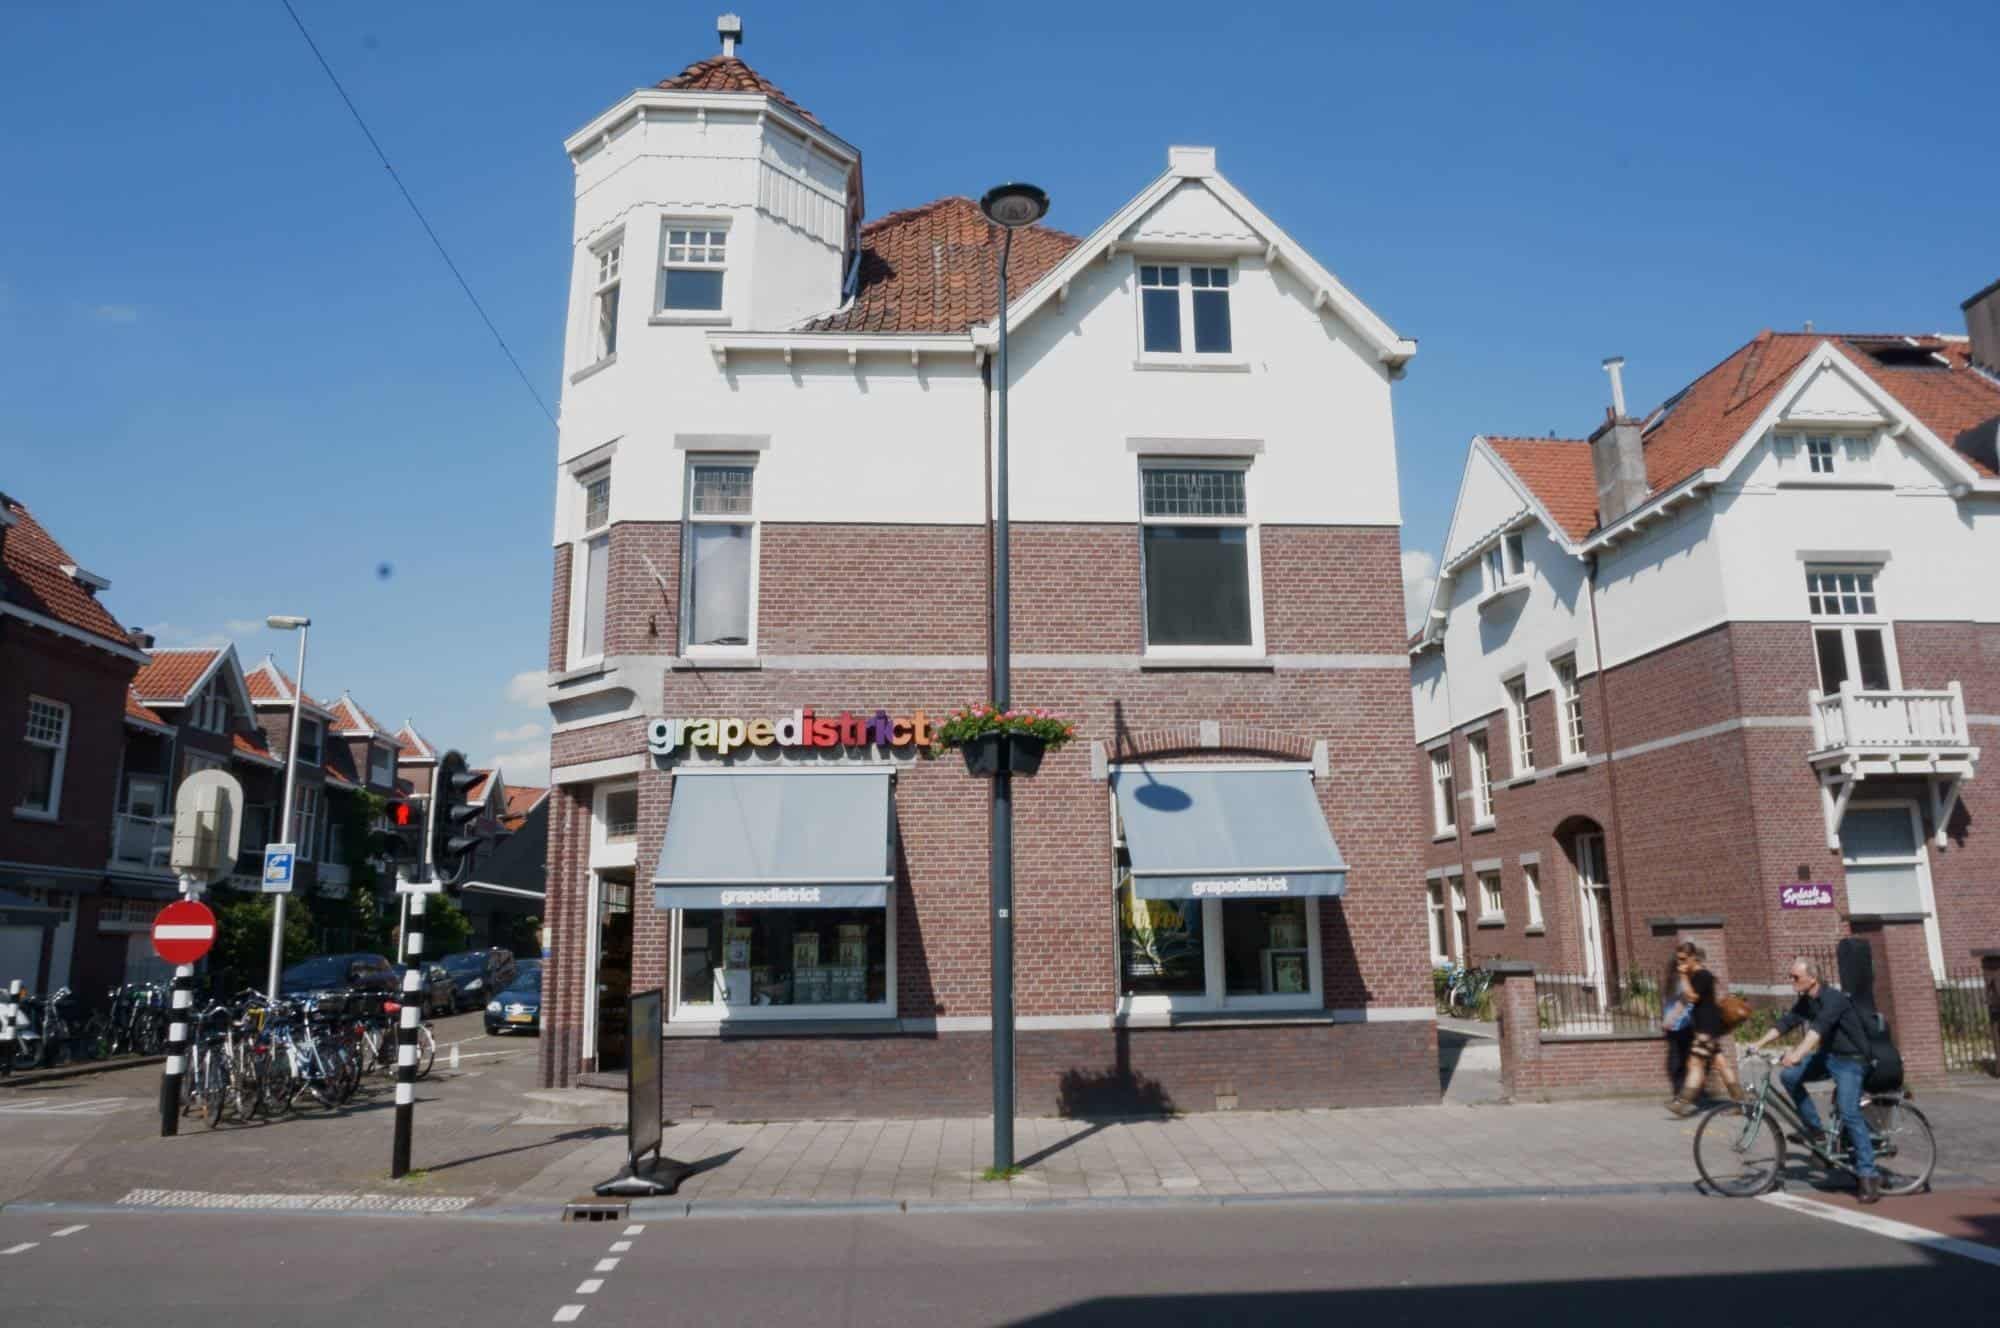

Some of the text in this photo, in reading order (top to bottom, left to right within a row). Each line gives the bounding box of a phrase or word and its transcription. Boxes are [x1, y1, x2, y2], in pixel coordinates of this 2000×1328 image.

[647, 709, 929, 754] grapedistrict
[721, 887, 820, 905] grapedistrict
[1192, 877, 1288, 896] grapedistrict
